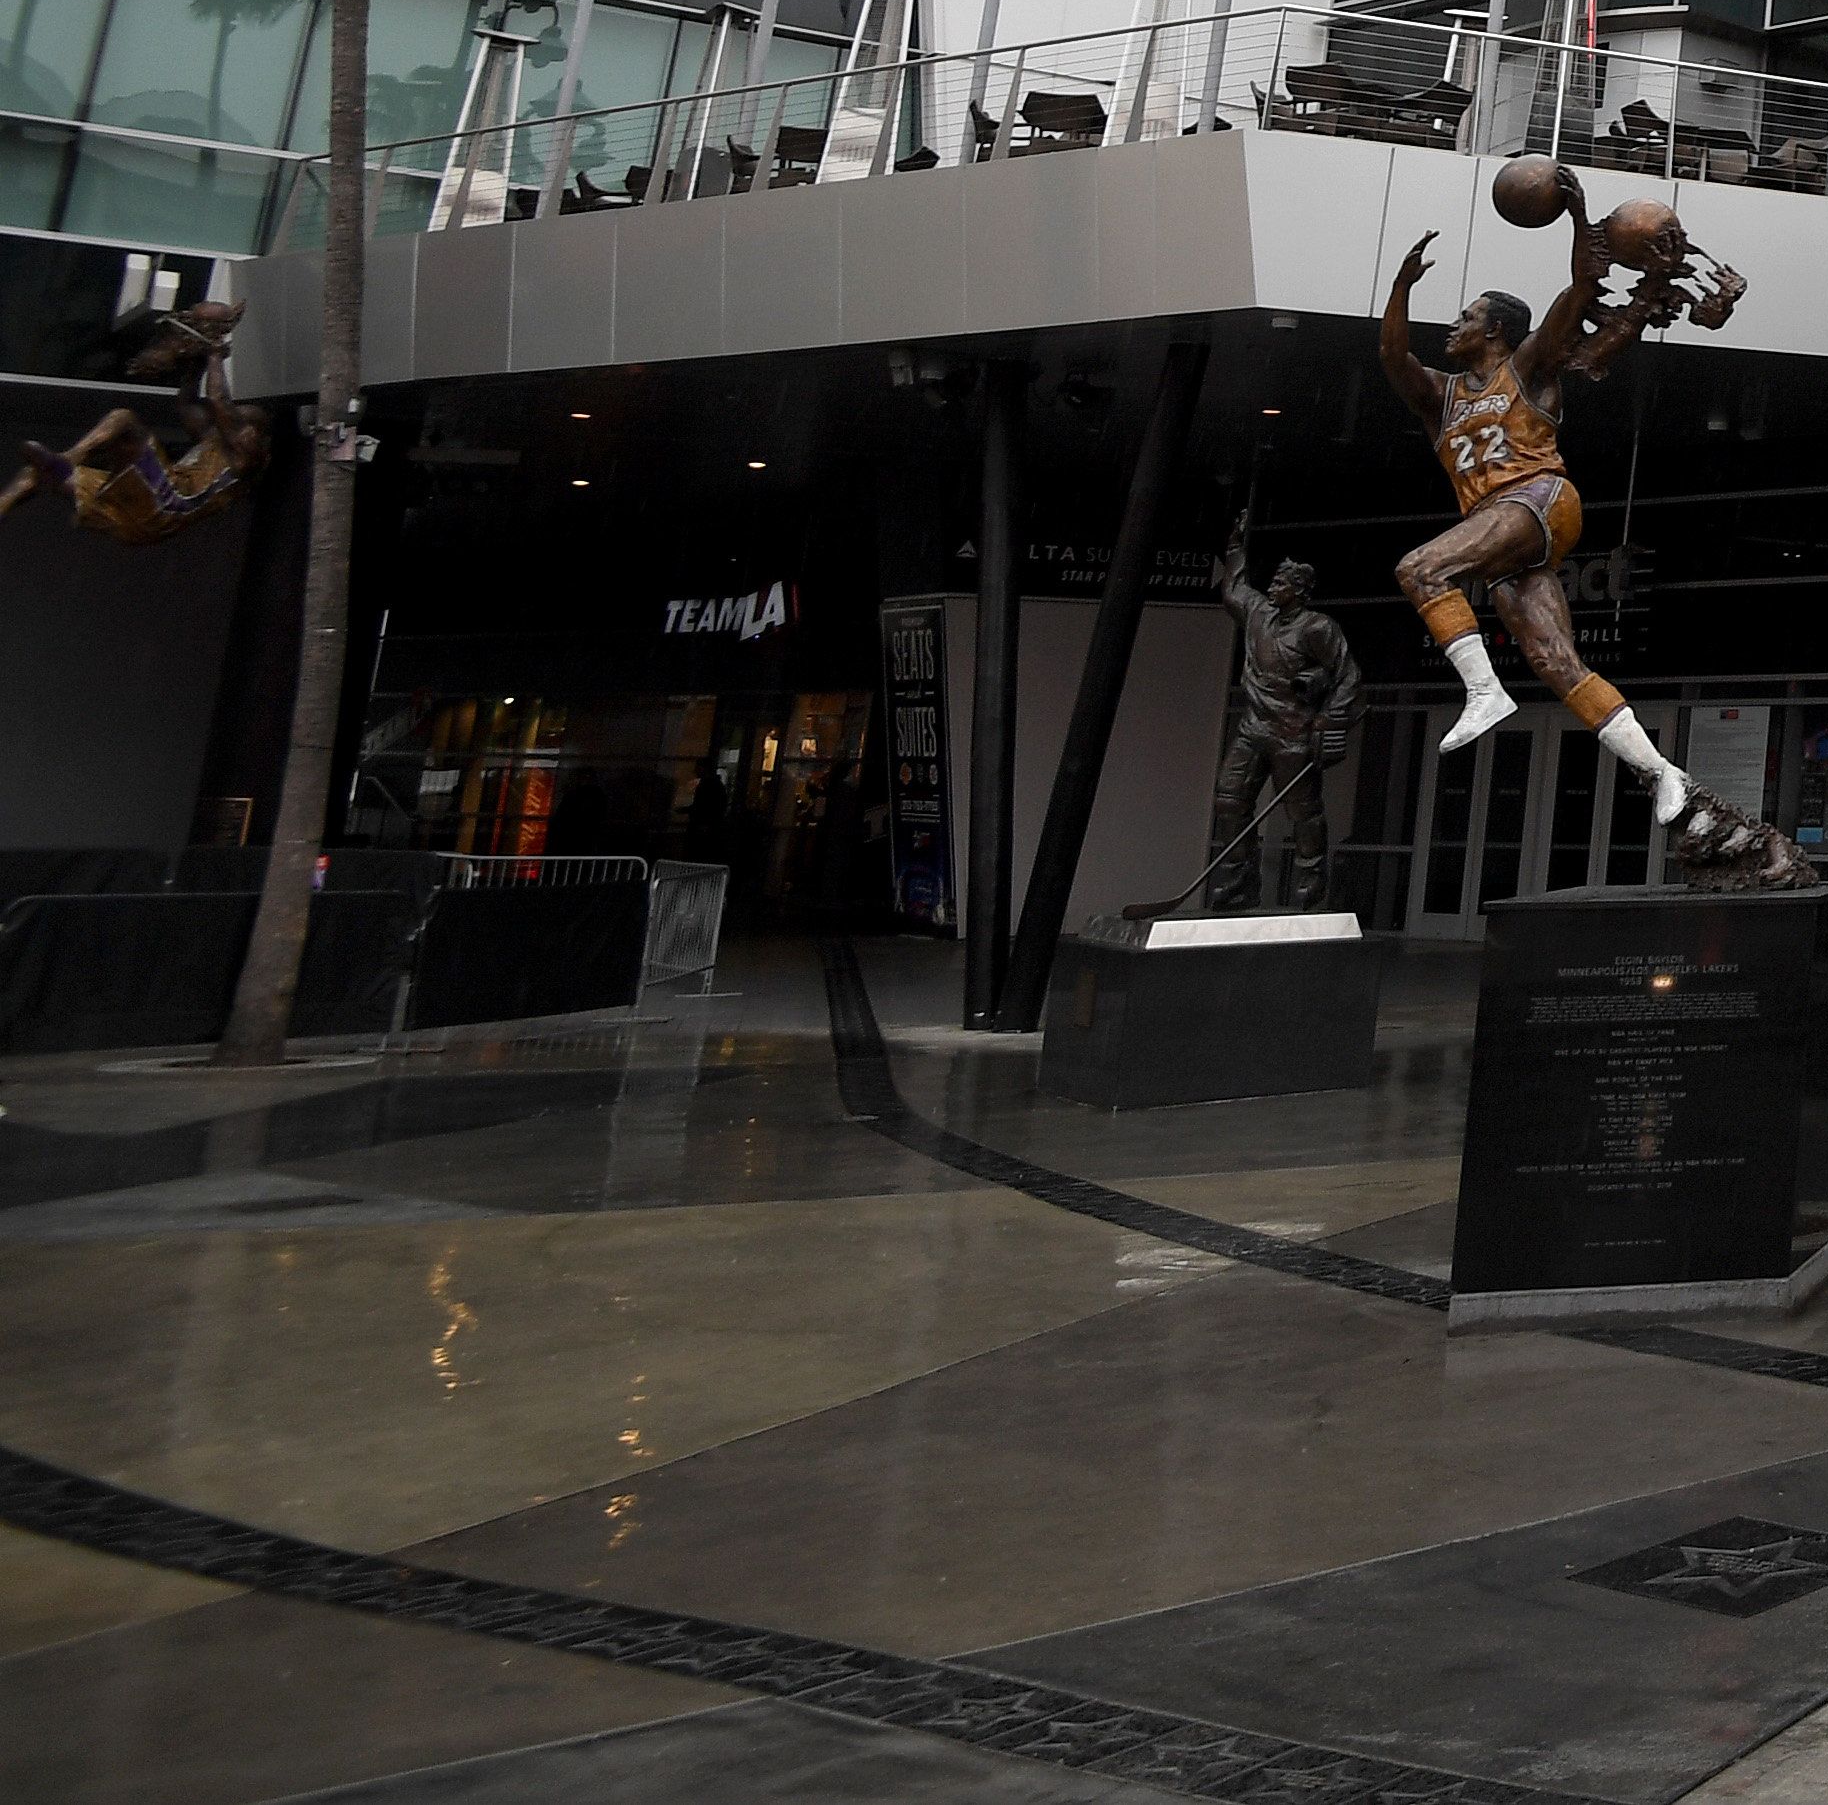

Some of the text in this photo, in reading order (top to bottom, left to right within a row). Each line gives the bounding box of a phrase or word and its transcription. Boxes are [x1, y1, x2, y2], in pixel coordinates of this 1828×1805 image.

[1450, 424, 1508, 473] 22
[1029, 544, 1075, 562] LTA
[1156, 550, 1210, 568] EVELS
[893, 628, 935, 681] SEATS
[896, 706, 937, 757] SUITES
